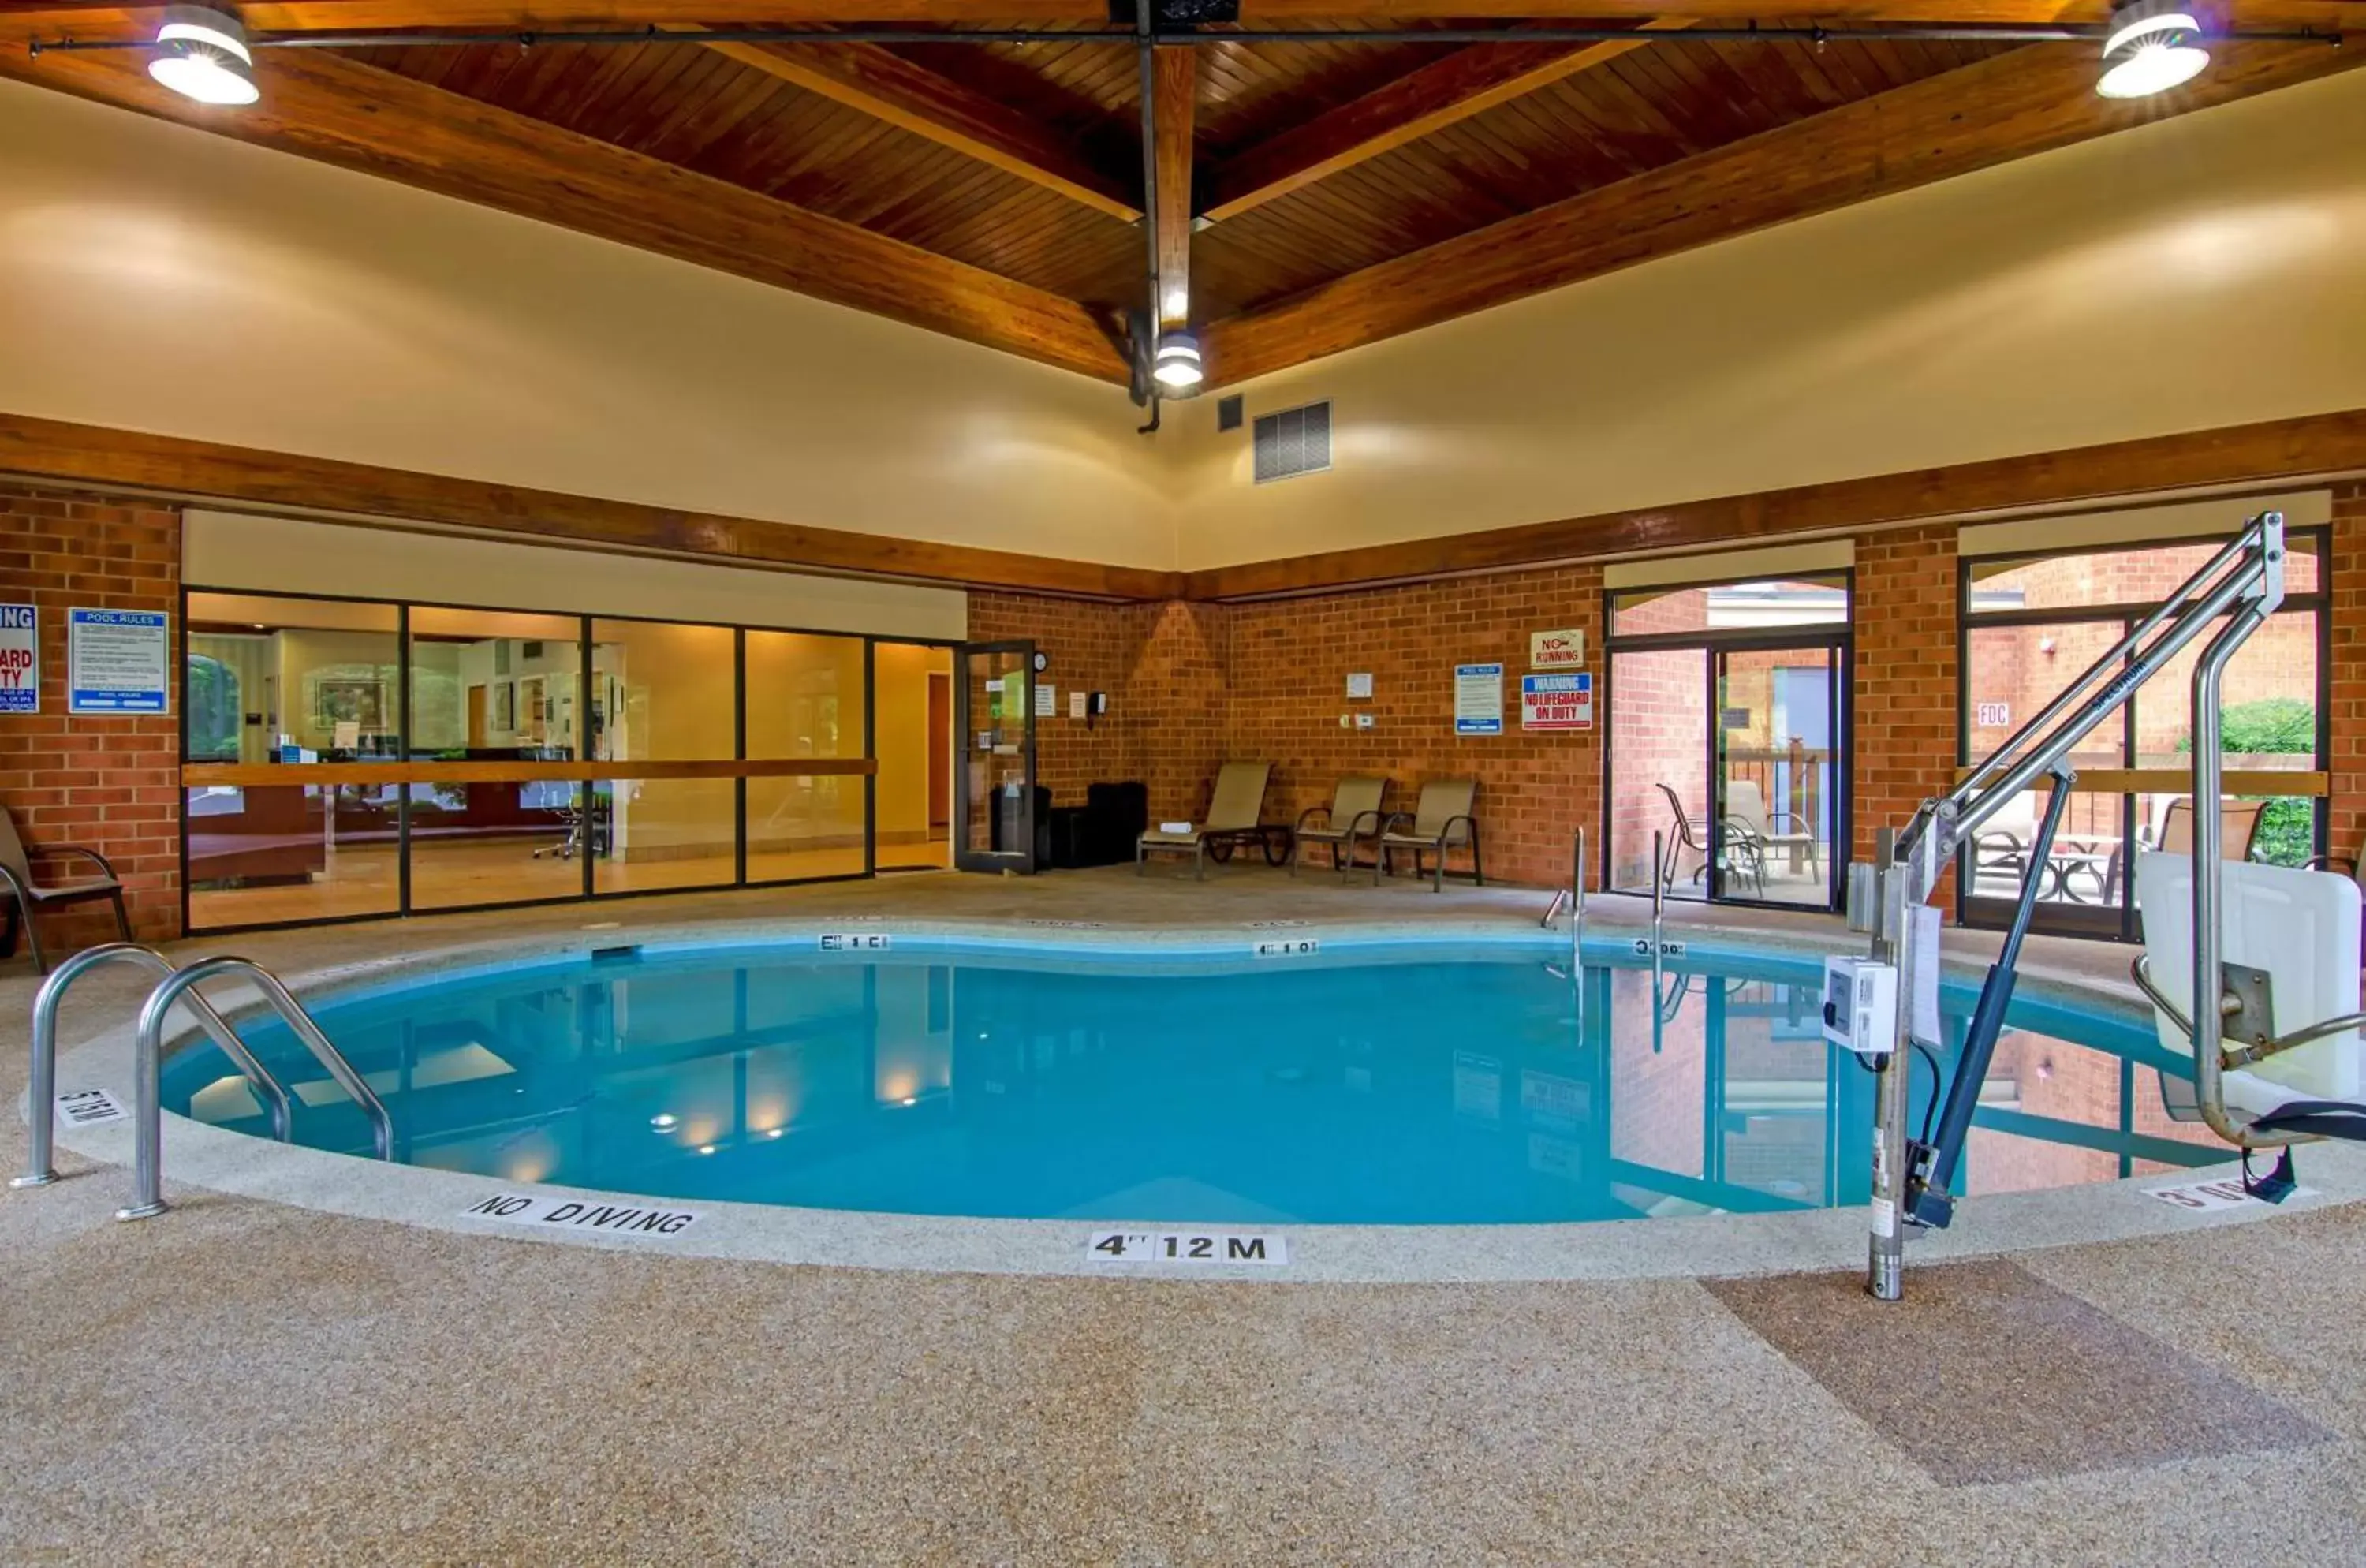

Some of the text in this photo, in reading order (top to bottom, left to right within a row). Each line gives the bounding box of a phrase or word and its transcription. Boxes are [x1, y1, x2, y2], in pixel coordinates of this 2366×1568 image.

[86, 614, 155, 625] POOL RULES
[0, 649, 32, 669] ARD
[1536, 650, 1579, 663] RUNNING
[2, 668, 21, 688] TY
[1534, 676, 1579, 693] WARNING
[1539, 692, 1589, 706] LIFEGUARD
[1536, 706, 1577, 720] ON DUTY
[1980, 704, 2006, 724] FDC
[469, 1195, 693, 1234] NO DIVING
[1228, 1238, 1266, 1260] M
